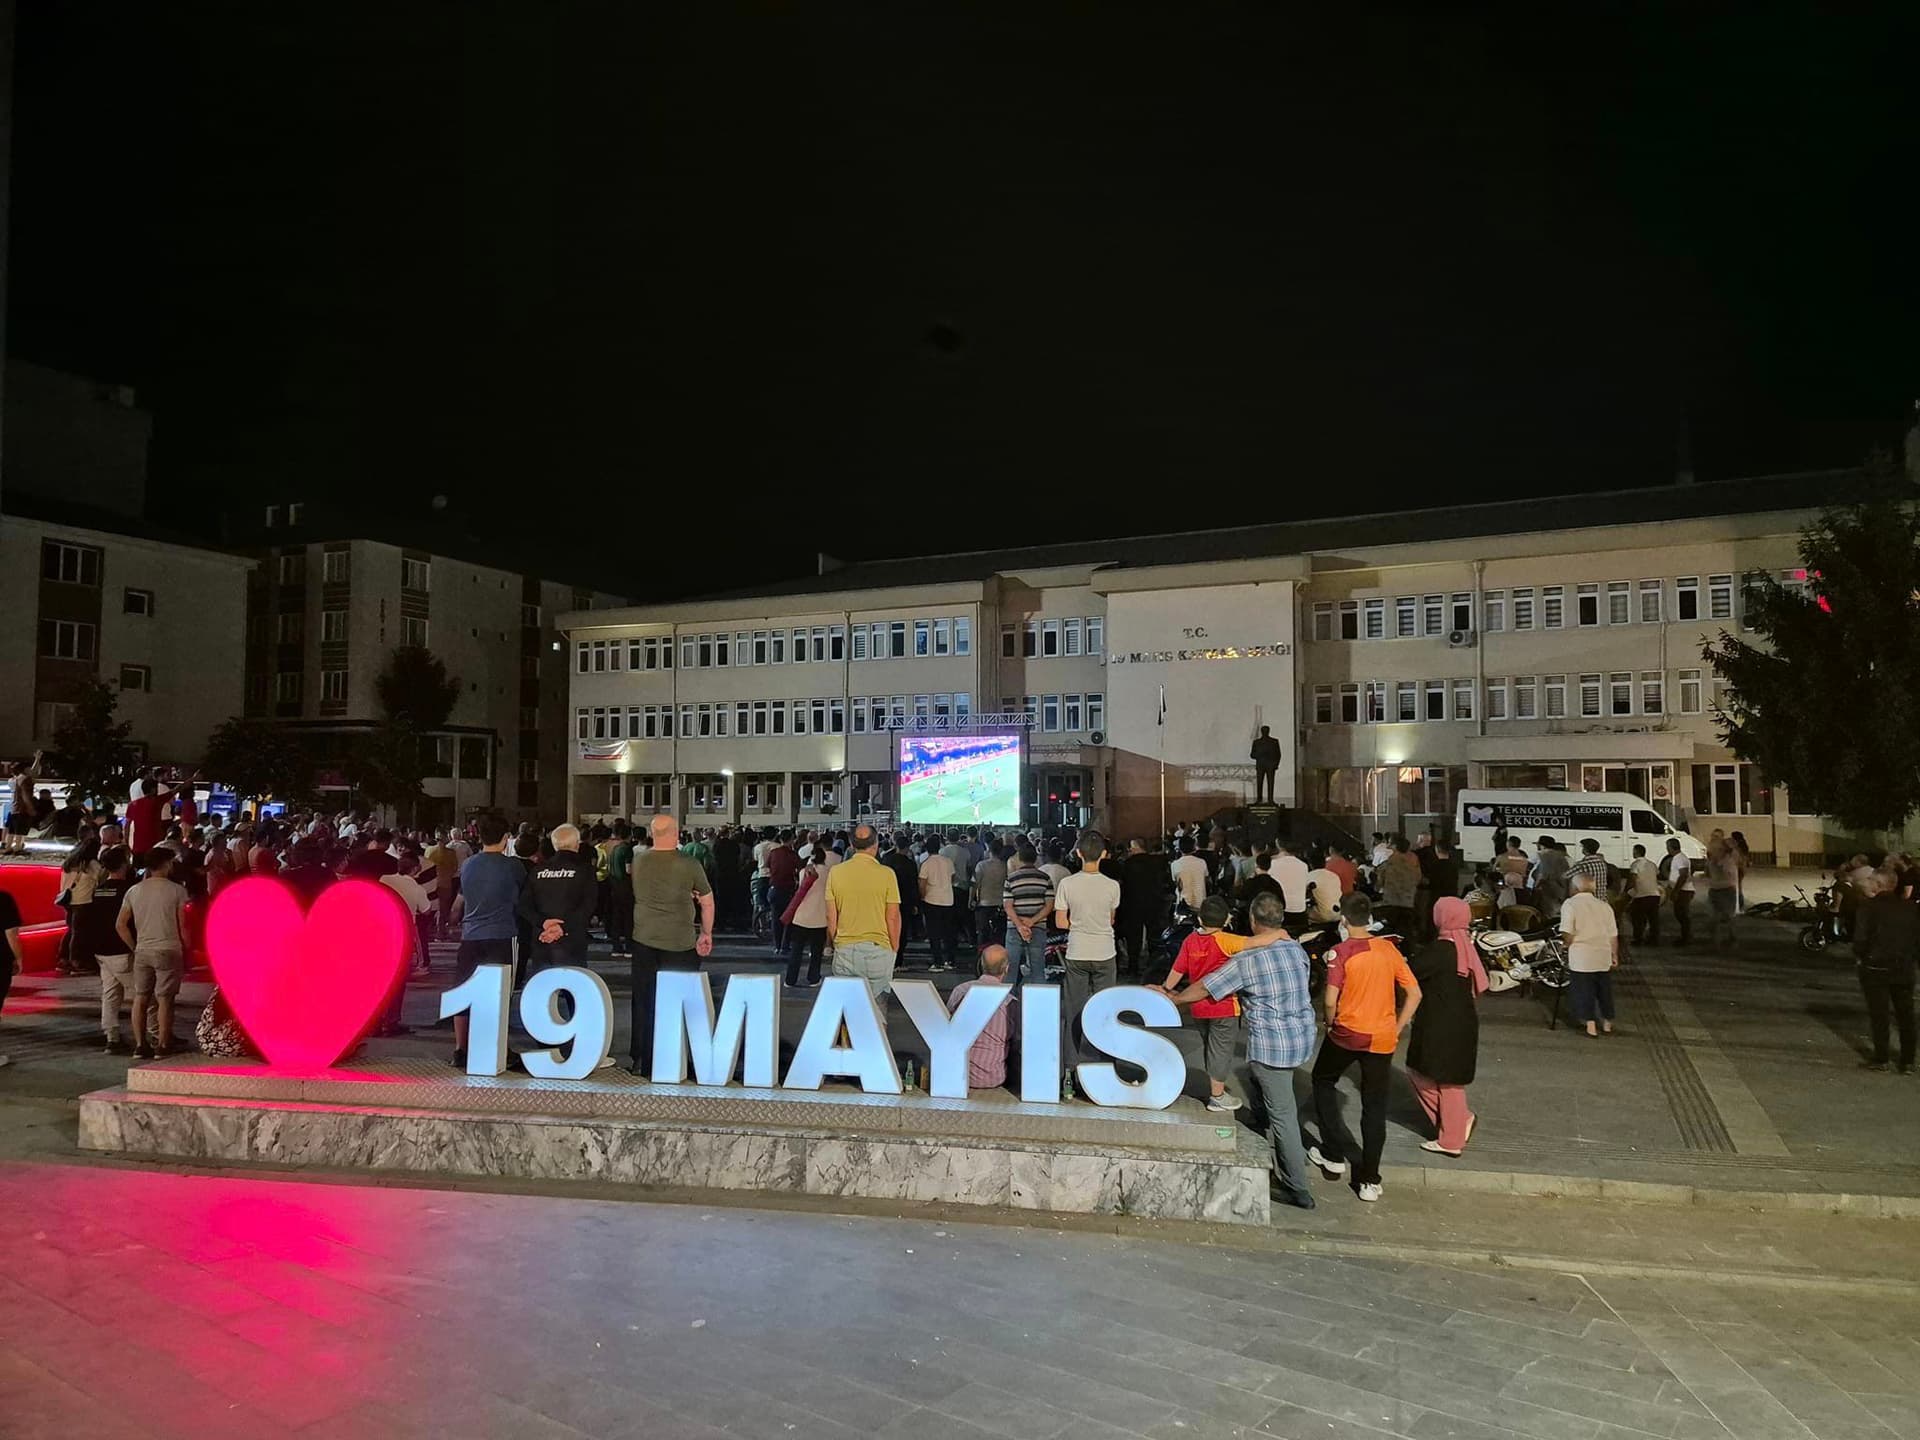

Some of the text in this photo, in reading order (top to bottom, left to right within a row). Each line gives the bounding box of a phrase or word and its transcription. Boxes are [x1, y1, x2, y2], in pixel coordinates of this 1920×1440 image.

[1183, 627, 1208, 639] T.C.
[1111, 653, 1126, 664] 19
[1593, 807, 1622, 815] EKRAN
[1504, 816, 1572, 827] EKNOLOJİ
[537, 868, 576, 879] TÜRKİYE
[440, 964, 1187, 1110] 19 MAYIS
